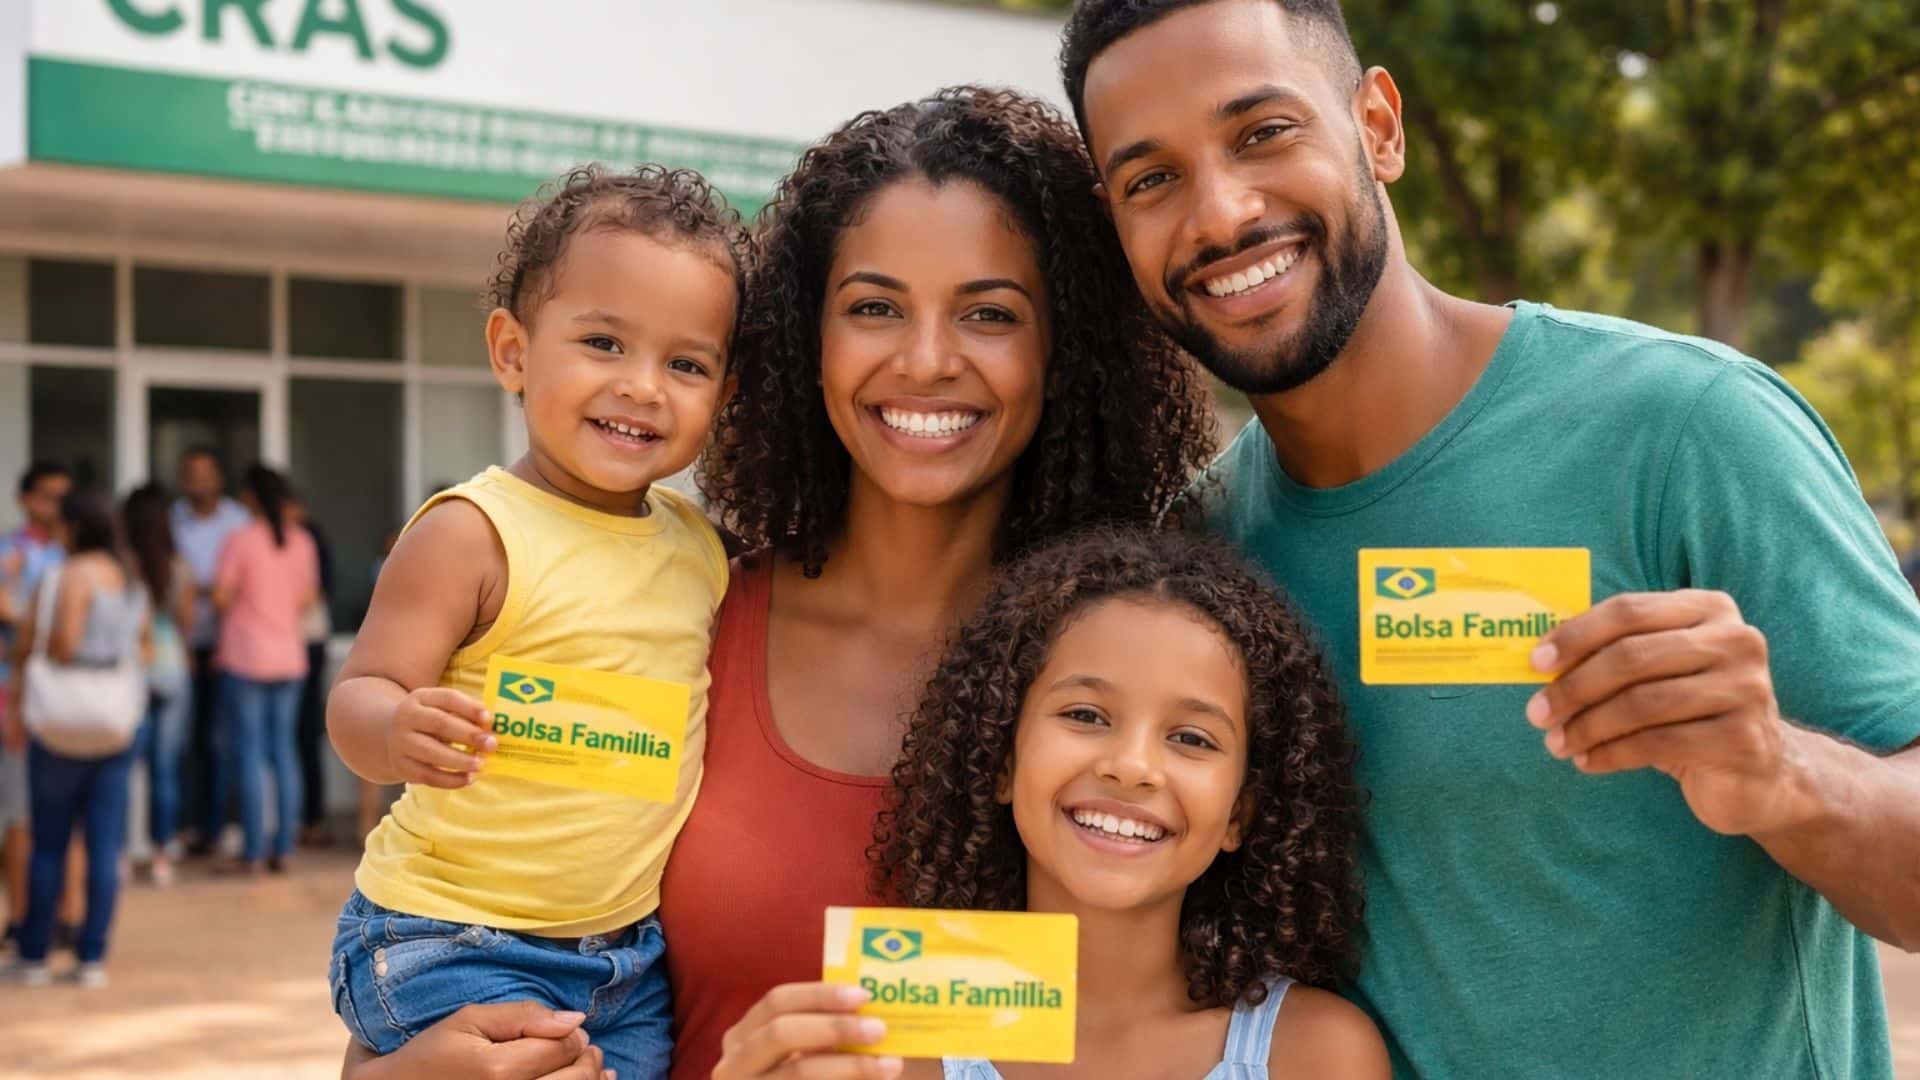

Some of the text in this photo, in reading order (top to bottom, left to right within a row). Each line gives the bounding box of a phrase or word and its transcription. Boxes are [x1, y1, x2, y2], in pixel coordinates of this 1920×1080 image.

[1375, 612, 1558, 639] Bolsa Familli
[492, 712, 562, 744] Bolsa
[570, 722, 671, 760] Famillia
[860, 977, 939, 1005] Bolsa
